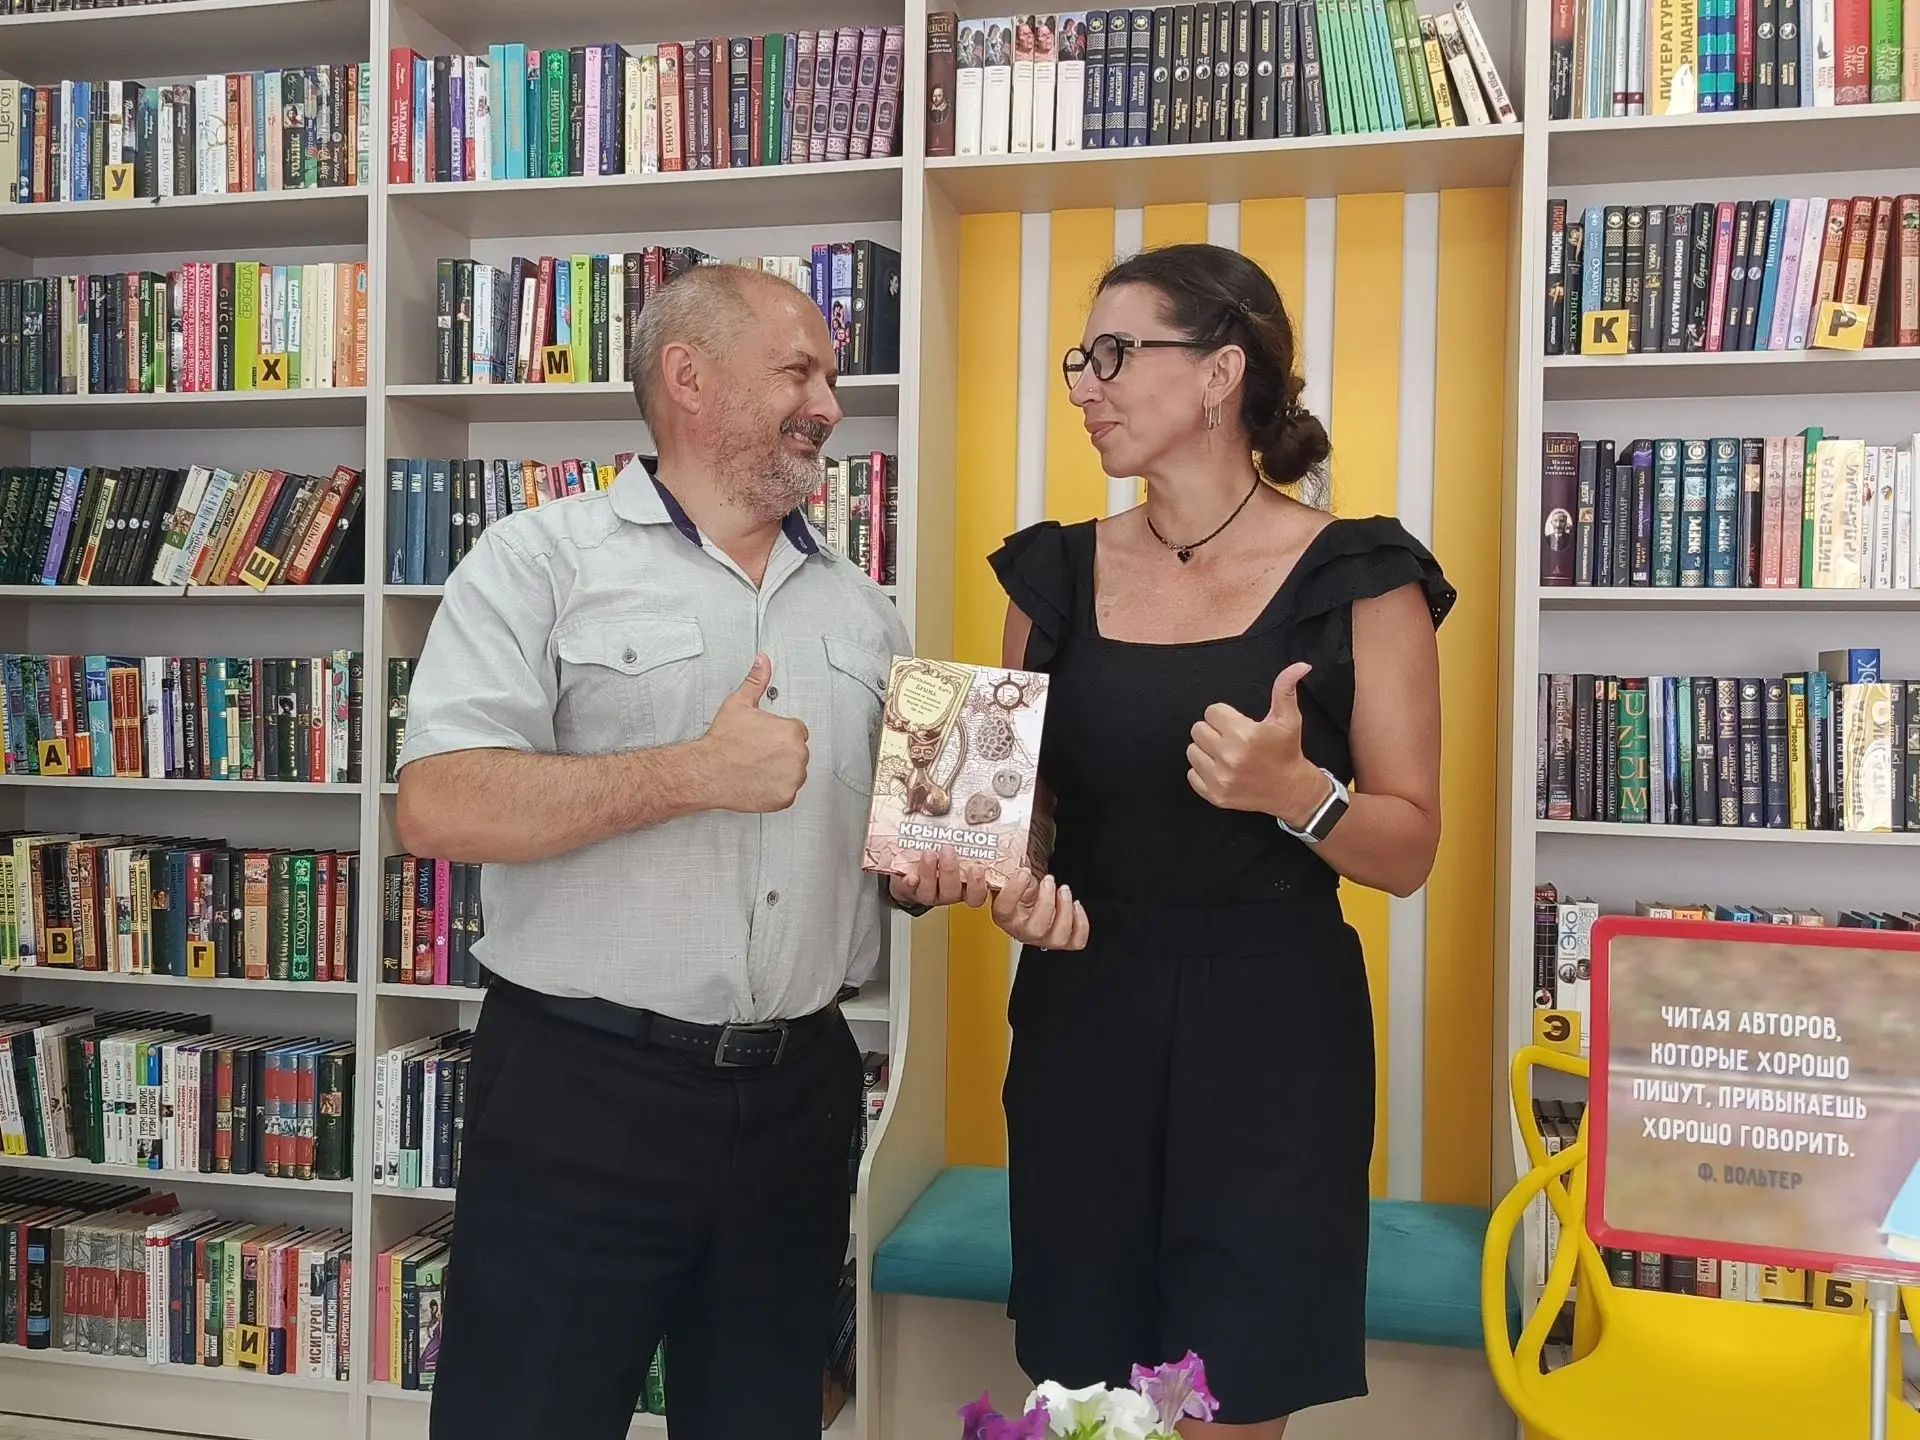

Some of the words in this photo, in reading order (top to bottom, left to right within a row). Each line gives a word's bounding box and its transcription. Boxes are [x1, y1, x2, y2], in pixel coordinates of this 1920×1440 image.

[1305, 26, 1314, 59] ШЕКСПИР
[1843, 45, 1855, 78] Эльбе
[1856, 45, 1868, 74] Огни
[1876, 45, 1889, 80] Эльбе
[1889, 47, 1900, 76] Буря
[391, 116, 399, 145] ГОРОД
[399, 98, 408, 162] ЗАГАДОЧНЫЙ
[551, 87, 559, 144] КИПЛИНГ
[665, 102, 674, 153] КОЛЛИНЗ
[291, 134, 301, 177] УОЛЛЕС
[111, 169, 127, 191] У
[1550, 231, 1563, 274] ЗЮСКИНД
[1736, 219, 1747, 257] МАЙРИНК
[1753, 219, 1763, 256] МАЙРИНК
[1648, 243, 1657, 269] КАФКА
[1674, 239, 1683, 278] СПИСОК
[242, 265, 253, 319] СВОБОДА
[1632, 277, 1640, 303] КАФКА
[1903, 278, 1913, 310] РЕМАРК
[219, 288, 229, 340] GUCCI
[357, 308, 367, 321] ВНЕ
[1569, 291, 1579, 343] ЗЮСКИНД
[1670, 281, 1681, 335] ШИНДЛЕРА
[1828, 309, 1857, 336] Р
[356, 323, 366, 341] ЗОНЫ
[1593, 317, 1619, 343] К
[261, 358, 282, 381] Х
[355, 343, 366, 372] ДОСТУПА
[546, 349, 568, 375] М
[50, 471, 64, 498] АРТУР
[829, 477, 837, 502] ОСТЕН
[829, 504, 837, 529] ДЖЕЙН
[1618, 497, 1628, 541] ШНИЦЛЕР
[858, 525, 869, 572] ОСТЕН
[1686, 516, 1702, 554] ЭБЕРС
[245, 552, 275, 582] Ш
[1618, 543, 1627, 569] АРТУР
[73, 672, 81, 692] ПУТЬ
[75, 696, 82, 707] НА
[1795, 698, 1805, 728] ГРЕЗЫ
[186, 714, 195, 748] ОСТРОВ
[1698, 697, 1707, 741] СЕРВАНТЕС
[44, 744, 62, 767] А
[1743, 743, 1751, 753] де
[1770, 744, 1778, 754] де
[1790, 725, 1798, 763] ЦИФРОВЫЕ
[1729, 743, 1737, 785] СЕРВАНТЕС
[1743, 755, 1752, 781] Мигель
[1752, 740, 1760, 784] СЕРВАНТЕС
[1770, 755, 1779, 783] Мигель
[898, 838, 996, 859] ПРИКЛЧЕНИЕ
[899, 822, 999, 846] КРЫМСКОЕ
[70, 868, 79, 883] ВО
[419, 867, 429, 903] УИЛБУР
[71, 887, 80, 923] ИВЛИН
[296, 890, 306, 949] ГОЛСУОРСИ
[52, 933, 67, 954] В
[1542, 1015, 1571, 1042] Э
[1661, 1005, 1730, 1031] ЧИТАЯ
[1738, 1012, 1842, 1042] АВТОРОВ,
[1650, 1042, 1749, 1071] КОТОРЫЕ
[1757, 1052, 1849, 1080] ХОРОШО
[139, 1088, 148, 1115] ДЖОЙС
[148, 1088, 156, 1115] ДЖОЙС
[1633, 1078, 1711, 1108] ПИШУТ,
[1719, 1086, 1867, 1120] ПРИВЫКАЕШЬ
[139, 1117, 148, 1136] ГРЭМ
[148, 1117, 156, 1136] ГРЭМ
[1642, 1117, 1731, 1146] ХОРОШО
[1740, 1125, 1855, 1158] ГОВОРИТЬ.
[1697, 1162, 1717, 1182] Ф.
[1724, 1165, 1803, 1190] ВОЛЬТЕР
[341, 1278, 351, 1298] МАТЬ
[1827, 1276, 1852, 1306] Б
[327, 1299, 336, 1331] ИСИГУРО
[341, 1299, 350, 1346] СУРРОГАТНАЯ
[241, 1329, 258, 1354] И
[310, 1309, 322, 1364] ИСИГУРО
